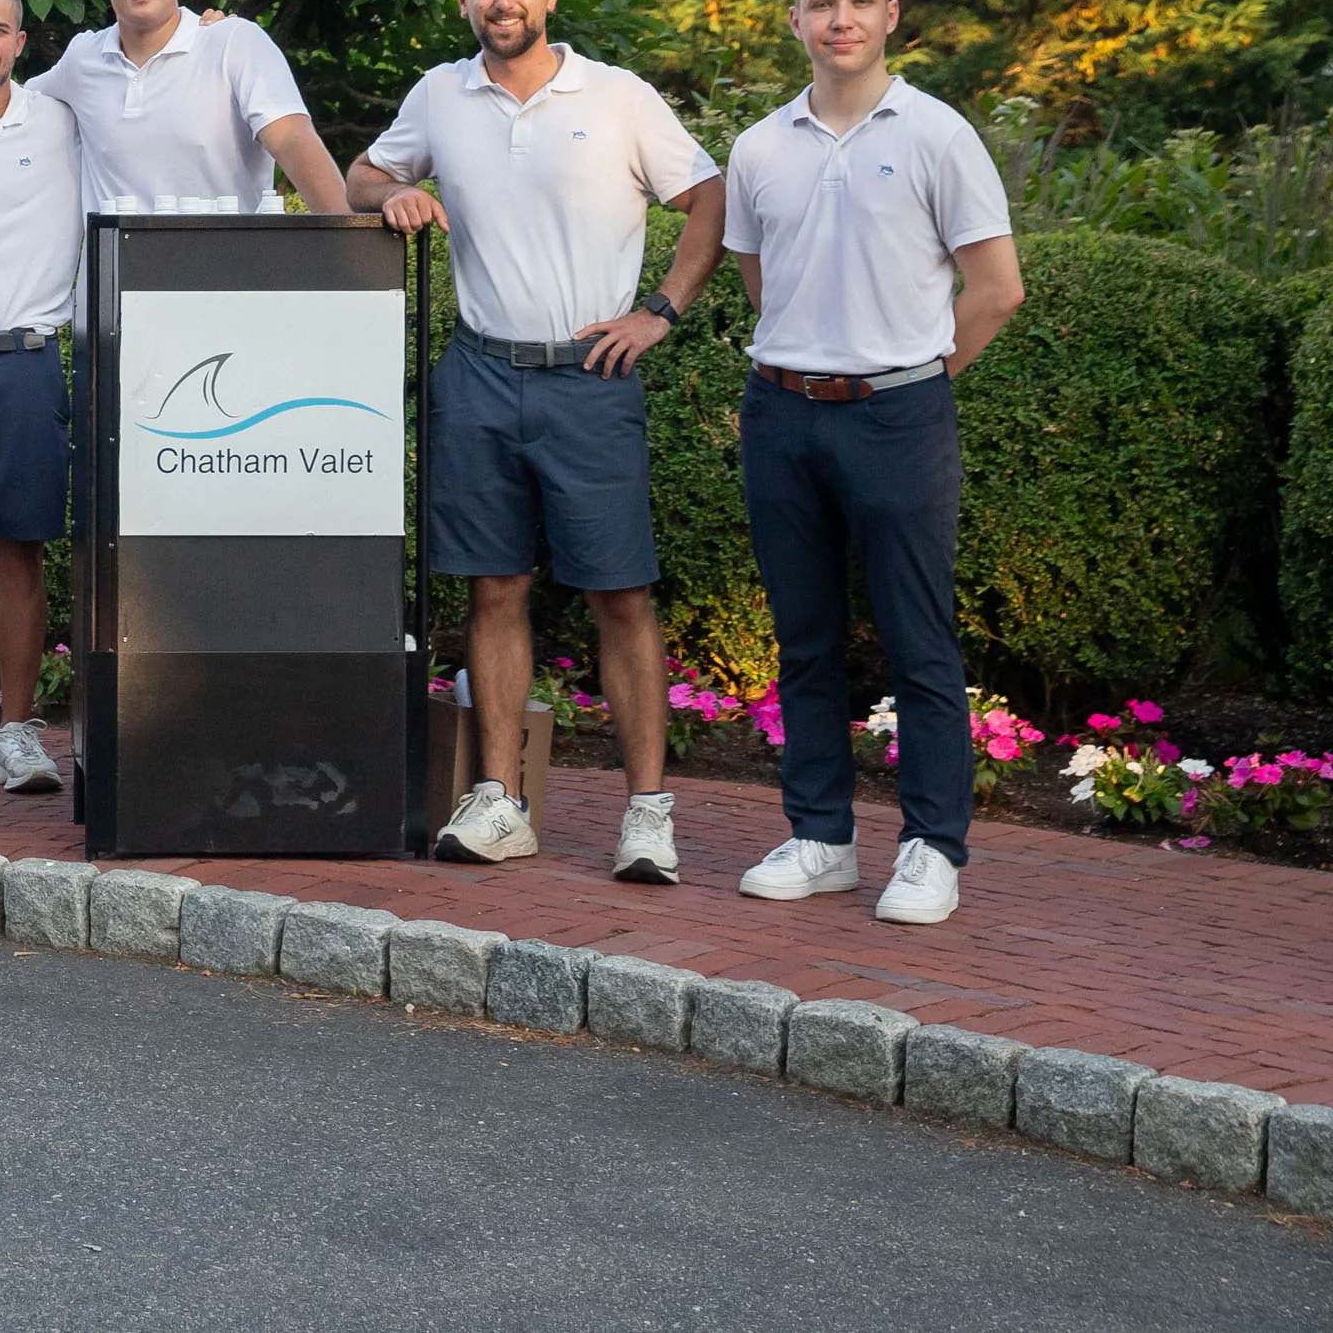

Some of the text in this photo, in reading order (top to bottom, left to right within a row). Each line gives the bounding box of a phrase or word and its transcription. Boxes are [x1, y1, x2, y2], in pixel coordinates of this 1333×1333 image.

[156, 447, 374, 474] Chatham Valet
[491, 814, 512, 840] N
